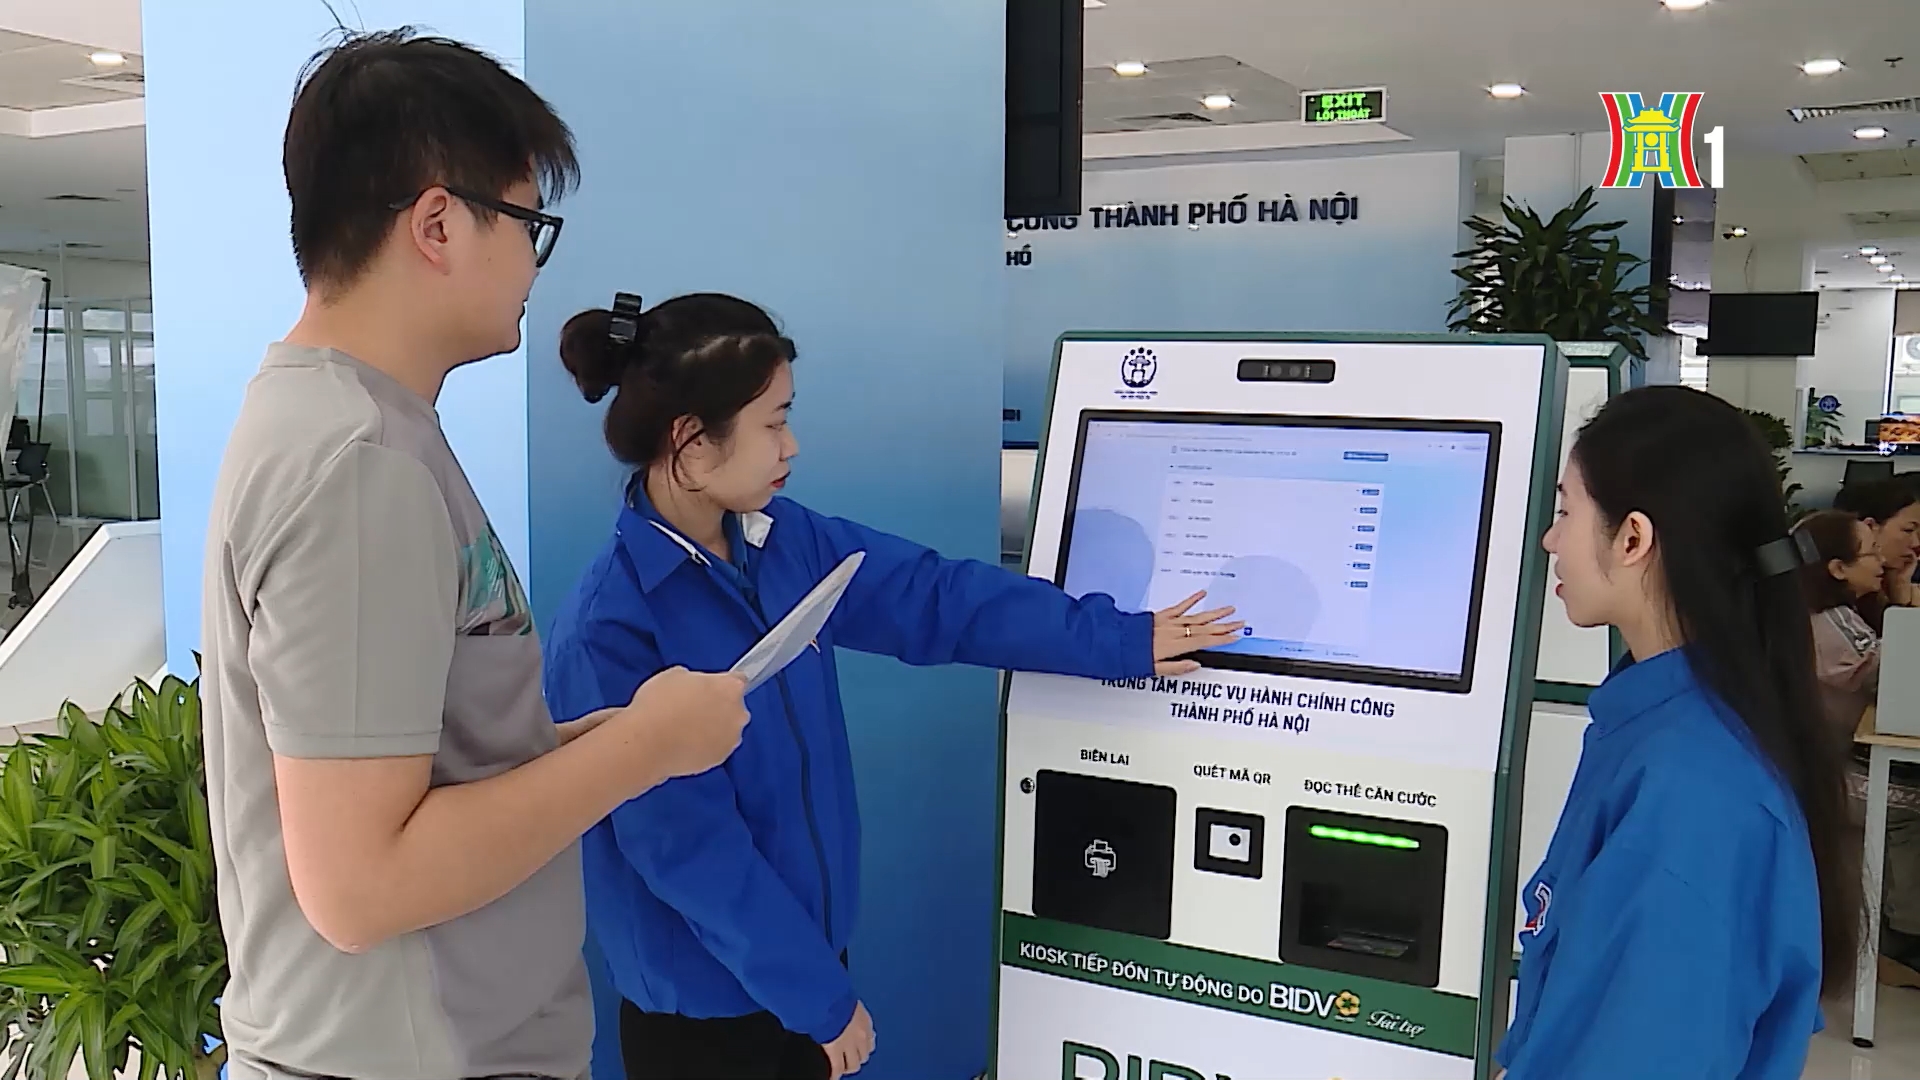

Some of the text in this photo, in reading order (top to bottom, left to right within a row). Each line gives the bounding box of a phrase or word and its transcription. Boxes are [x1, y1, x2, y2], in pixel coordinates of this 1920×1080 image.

[1321, 93, 1367, 108] EXIT
[1089, 201, 1179, 228] THÀNH
[1189, 193, 1248, 225] PHỐ
[1258, 193, 1298, 222] HÀ
[1309, 191, 1358, 226] NỘI
[1150, 675, 1178, 694] TÂM
[1182, 681, 1222, 699] PHỤC
[1227, 685, 1246, 703] VỤ
[1251, 686, 1292, 705] HÀNH
[1297, 692, 1345, 711] CHÍNH
[1351, 697, 1395, 718] CÔNG
[1171, 702, 1310, 735] THÀNH PHỐ HÀ NỘI
[1080, 748, 1129, 766] BIÊN LAI
[1253, 772, 1271, 785] QR
[1304, 779, 1332, 794] ĐỌC
[1020, 942, 1068, 966] KIOSK
[1072, 952, 1108, 973] TIẾP
[1112, 961, 1149, 983] ĐÓN
[1153, 969, 1180, 990] TỰ
[1182, 974, 1233, 999] ĐỘNG
[1238, 984, 1263, 1004] DO
[1269, 983, 1337, 1017] BIDV
